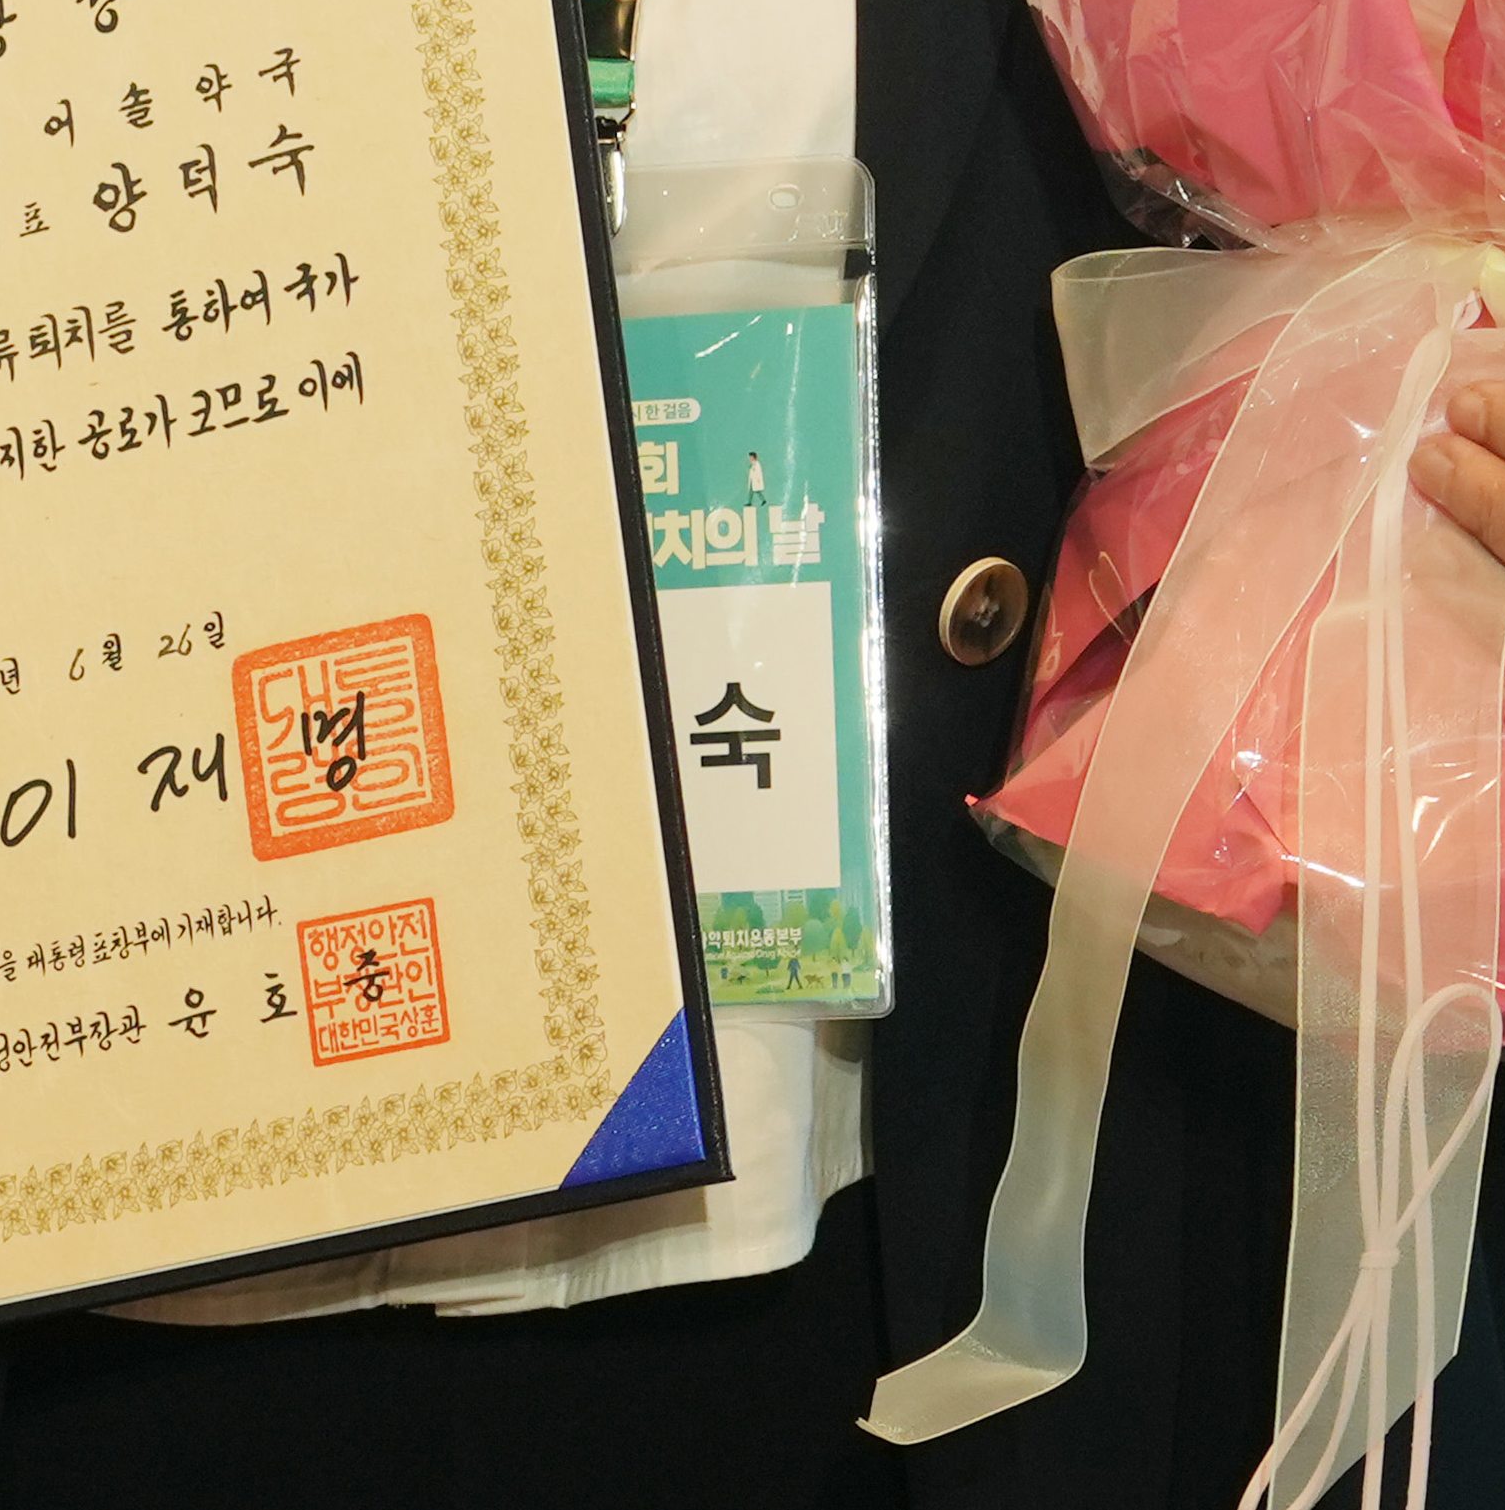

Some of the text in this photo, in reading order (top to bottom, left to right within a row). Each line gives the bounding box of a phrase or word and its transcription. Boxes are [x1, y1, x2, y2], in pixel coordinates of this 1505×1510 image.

[28, 299, 137, 368] 퇴치를
[161, 269, 271, 342] 통하여
[283, 251, 360, 312] 국가
[77, 393, 178, 461] 공로가
[187, 374, 289, 438] 크므로
[297, 351, 365, 412] 이에
[645, 403, 660, 421] 한
[663, 401, 693, 421] 걸음
[768, 502, 826, 567] 날
[687, 681, 782, 790] 숙
[26, 935, 86, 977] 대통령
[92, 917, 172, 965] 표창부에
[176, 893, 283, 947] 기재합니다.
